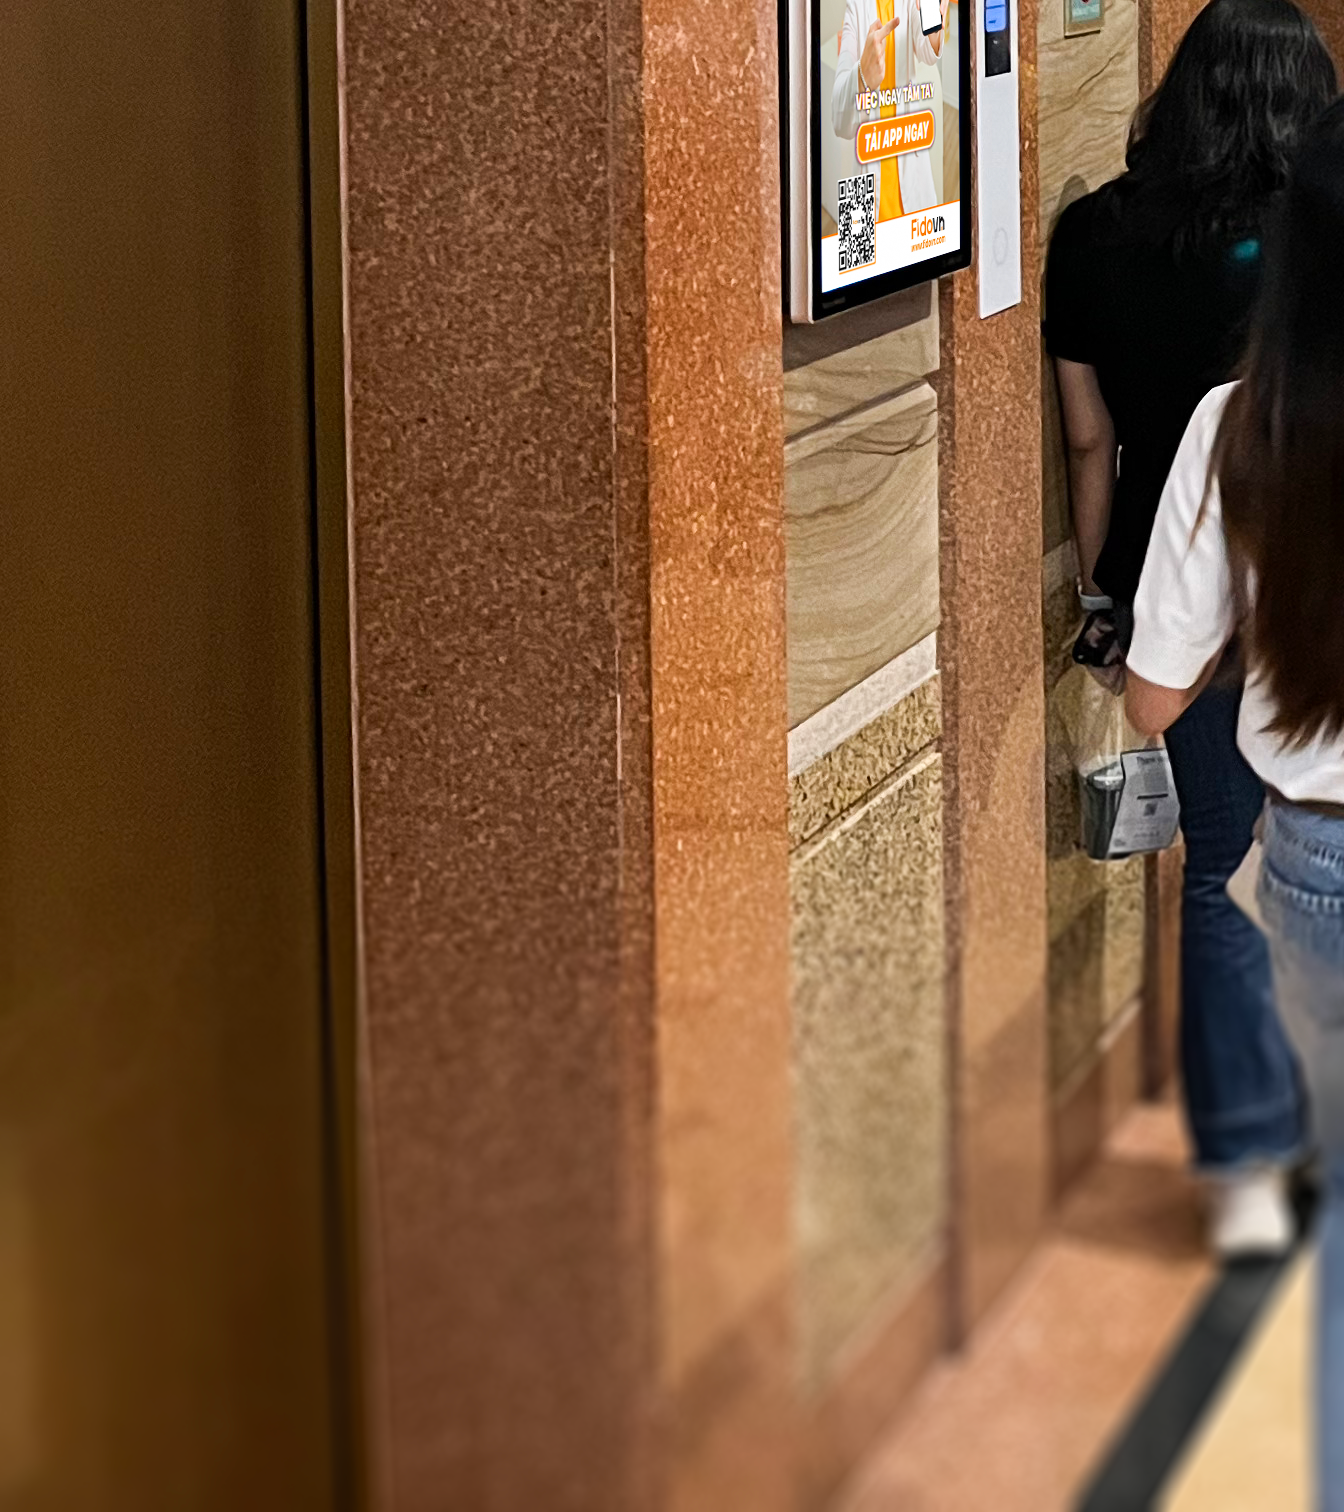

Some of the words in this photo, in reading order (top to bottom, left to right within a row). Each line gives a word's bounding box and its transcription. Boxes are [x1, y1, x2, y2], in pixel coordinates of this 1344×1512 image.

[856, 88, 878, 114] VIỆC
[879, 88, 902, 107] NGAY
[921, 83, 935, 99] TAY
[865, 127, 881, 153] TẢI
[882, 126, 903, 149] APP
[904, 121, 930, 144] NGAY
[911, 214, 945, 239] Fidovn
